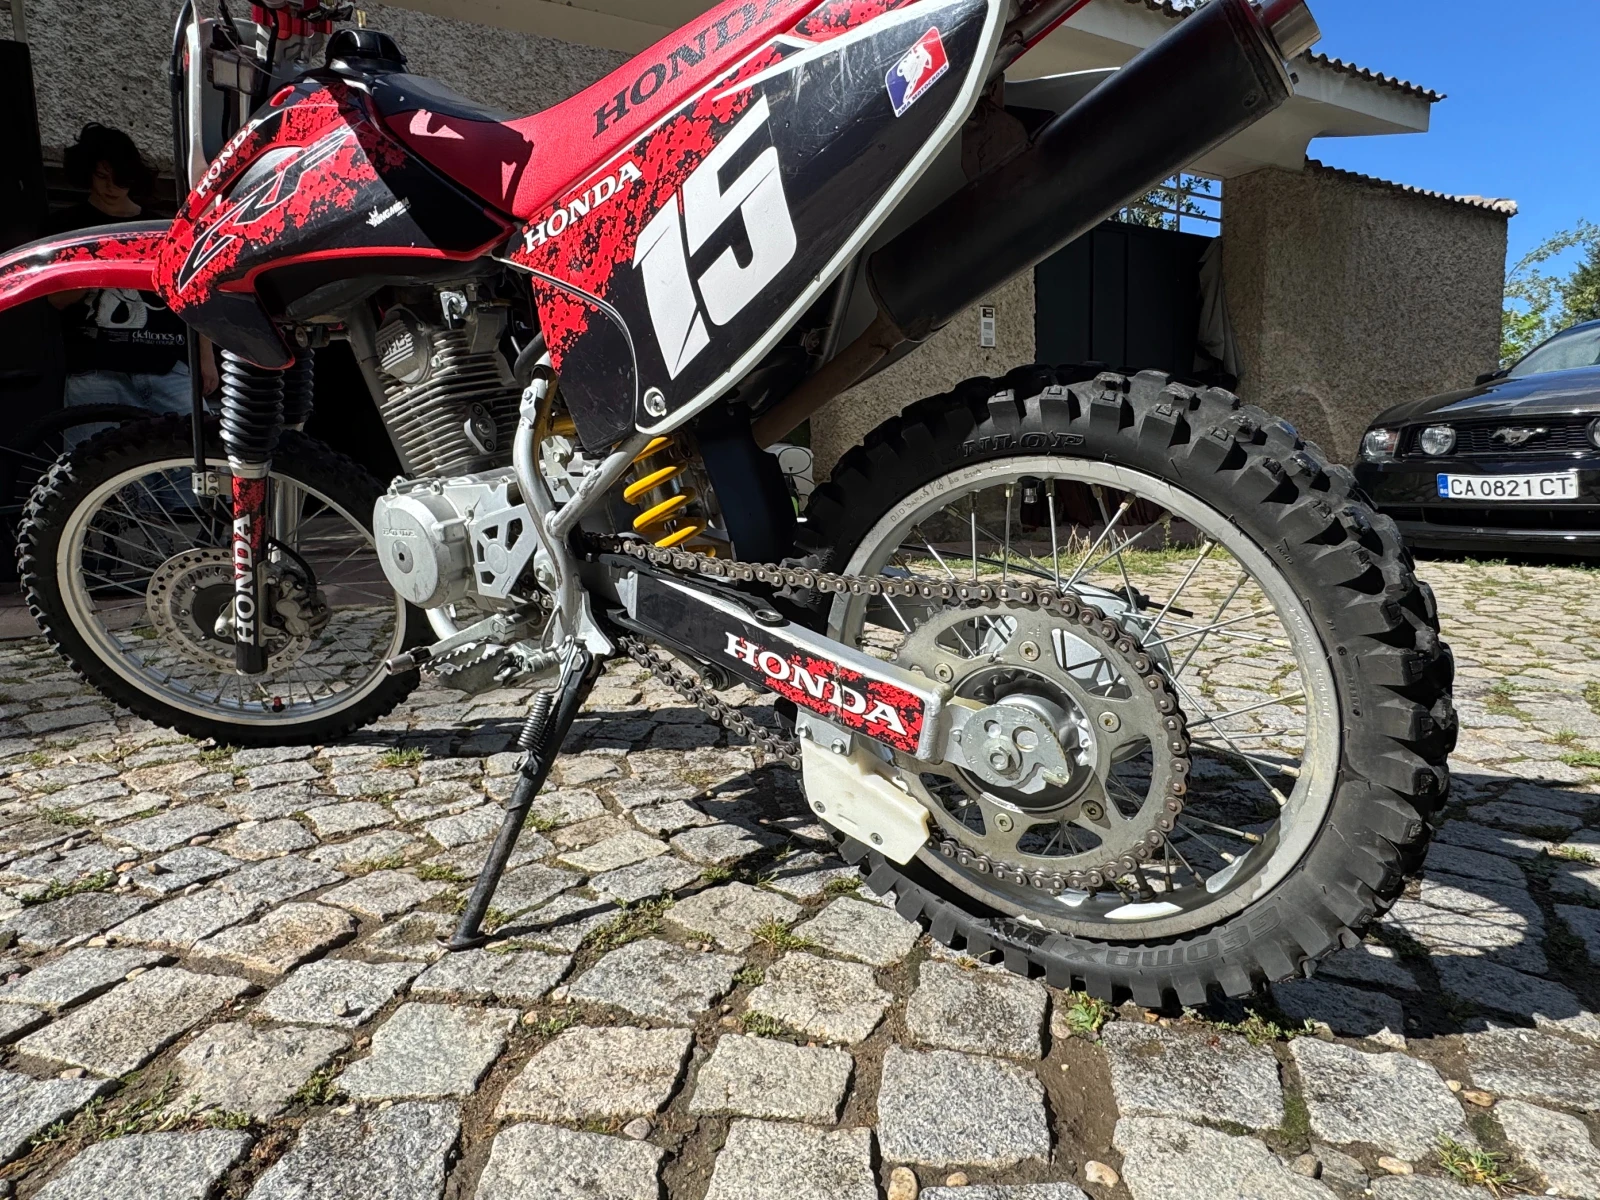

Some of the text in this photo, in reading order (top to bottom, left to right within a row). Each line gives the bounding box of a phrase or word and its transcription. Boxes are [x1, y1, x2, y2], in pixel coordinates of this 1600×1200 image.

[897, 64, 948, 116] AMA MOTOCROSS
[196, 119, 263, 198] HONDA
[523, 160, 643, 254] HONDA
[632, 94, 798, 381] 15
[233, 513, 256, 646] HONDA
[724, 631, 909, 736] HONDA
